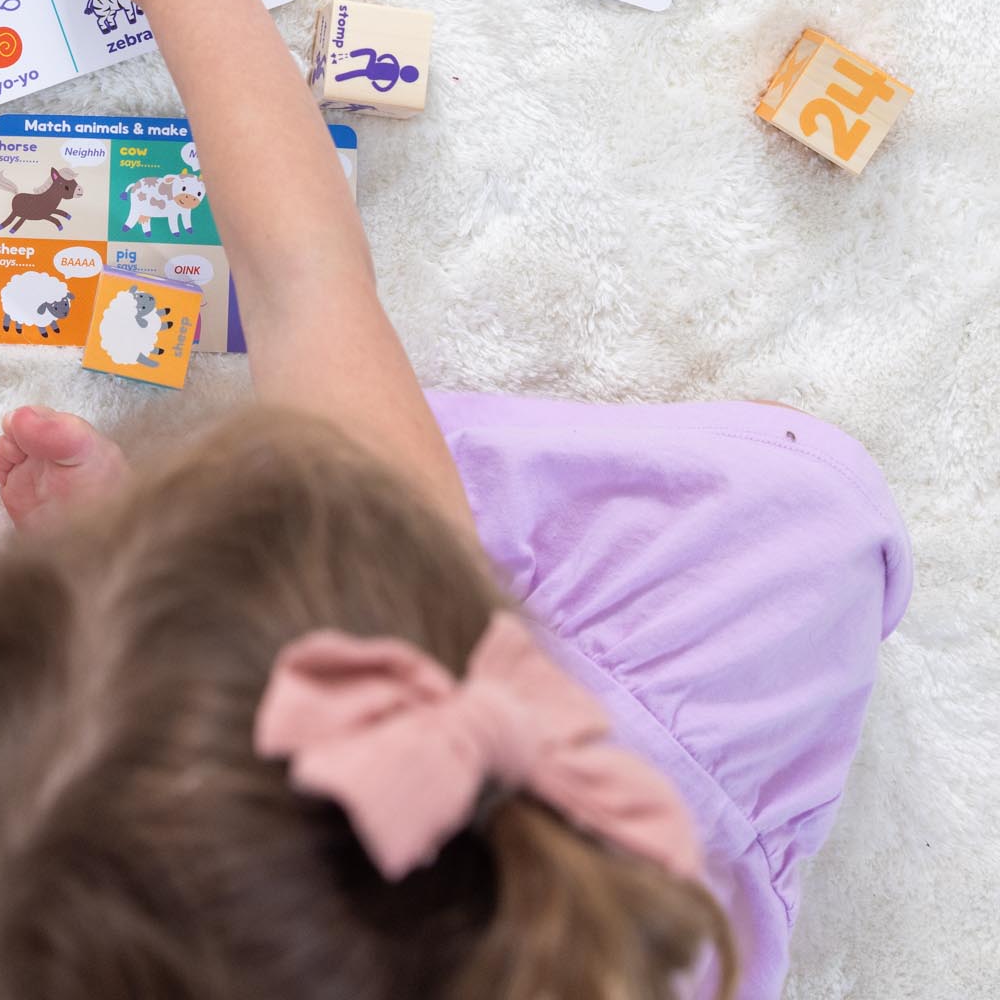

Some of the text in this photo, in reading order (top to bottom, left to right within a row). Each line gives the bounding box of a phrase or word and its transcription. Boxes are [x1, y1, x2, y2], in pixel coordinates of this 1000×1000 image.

[332, 5, 349, 48] stomp
[106, 30, 154, 54] zebra
[799, 57, 895, 162] 24
[24, 119, 188, 137] Match animals & make
[64, 147, 106, 158] Neighhh
[119, 146, 148, 157] cow
[60, 257, 96, 267] BAAAA
[116, 249, 137, 263] pig
[174, 265, 201, 276] OINK
[174, 316, 193, 358] sheep
